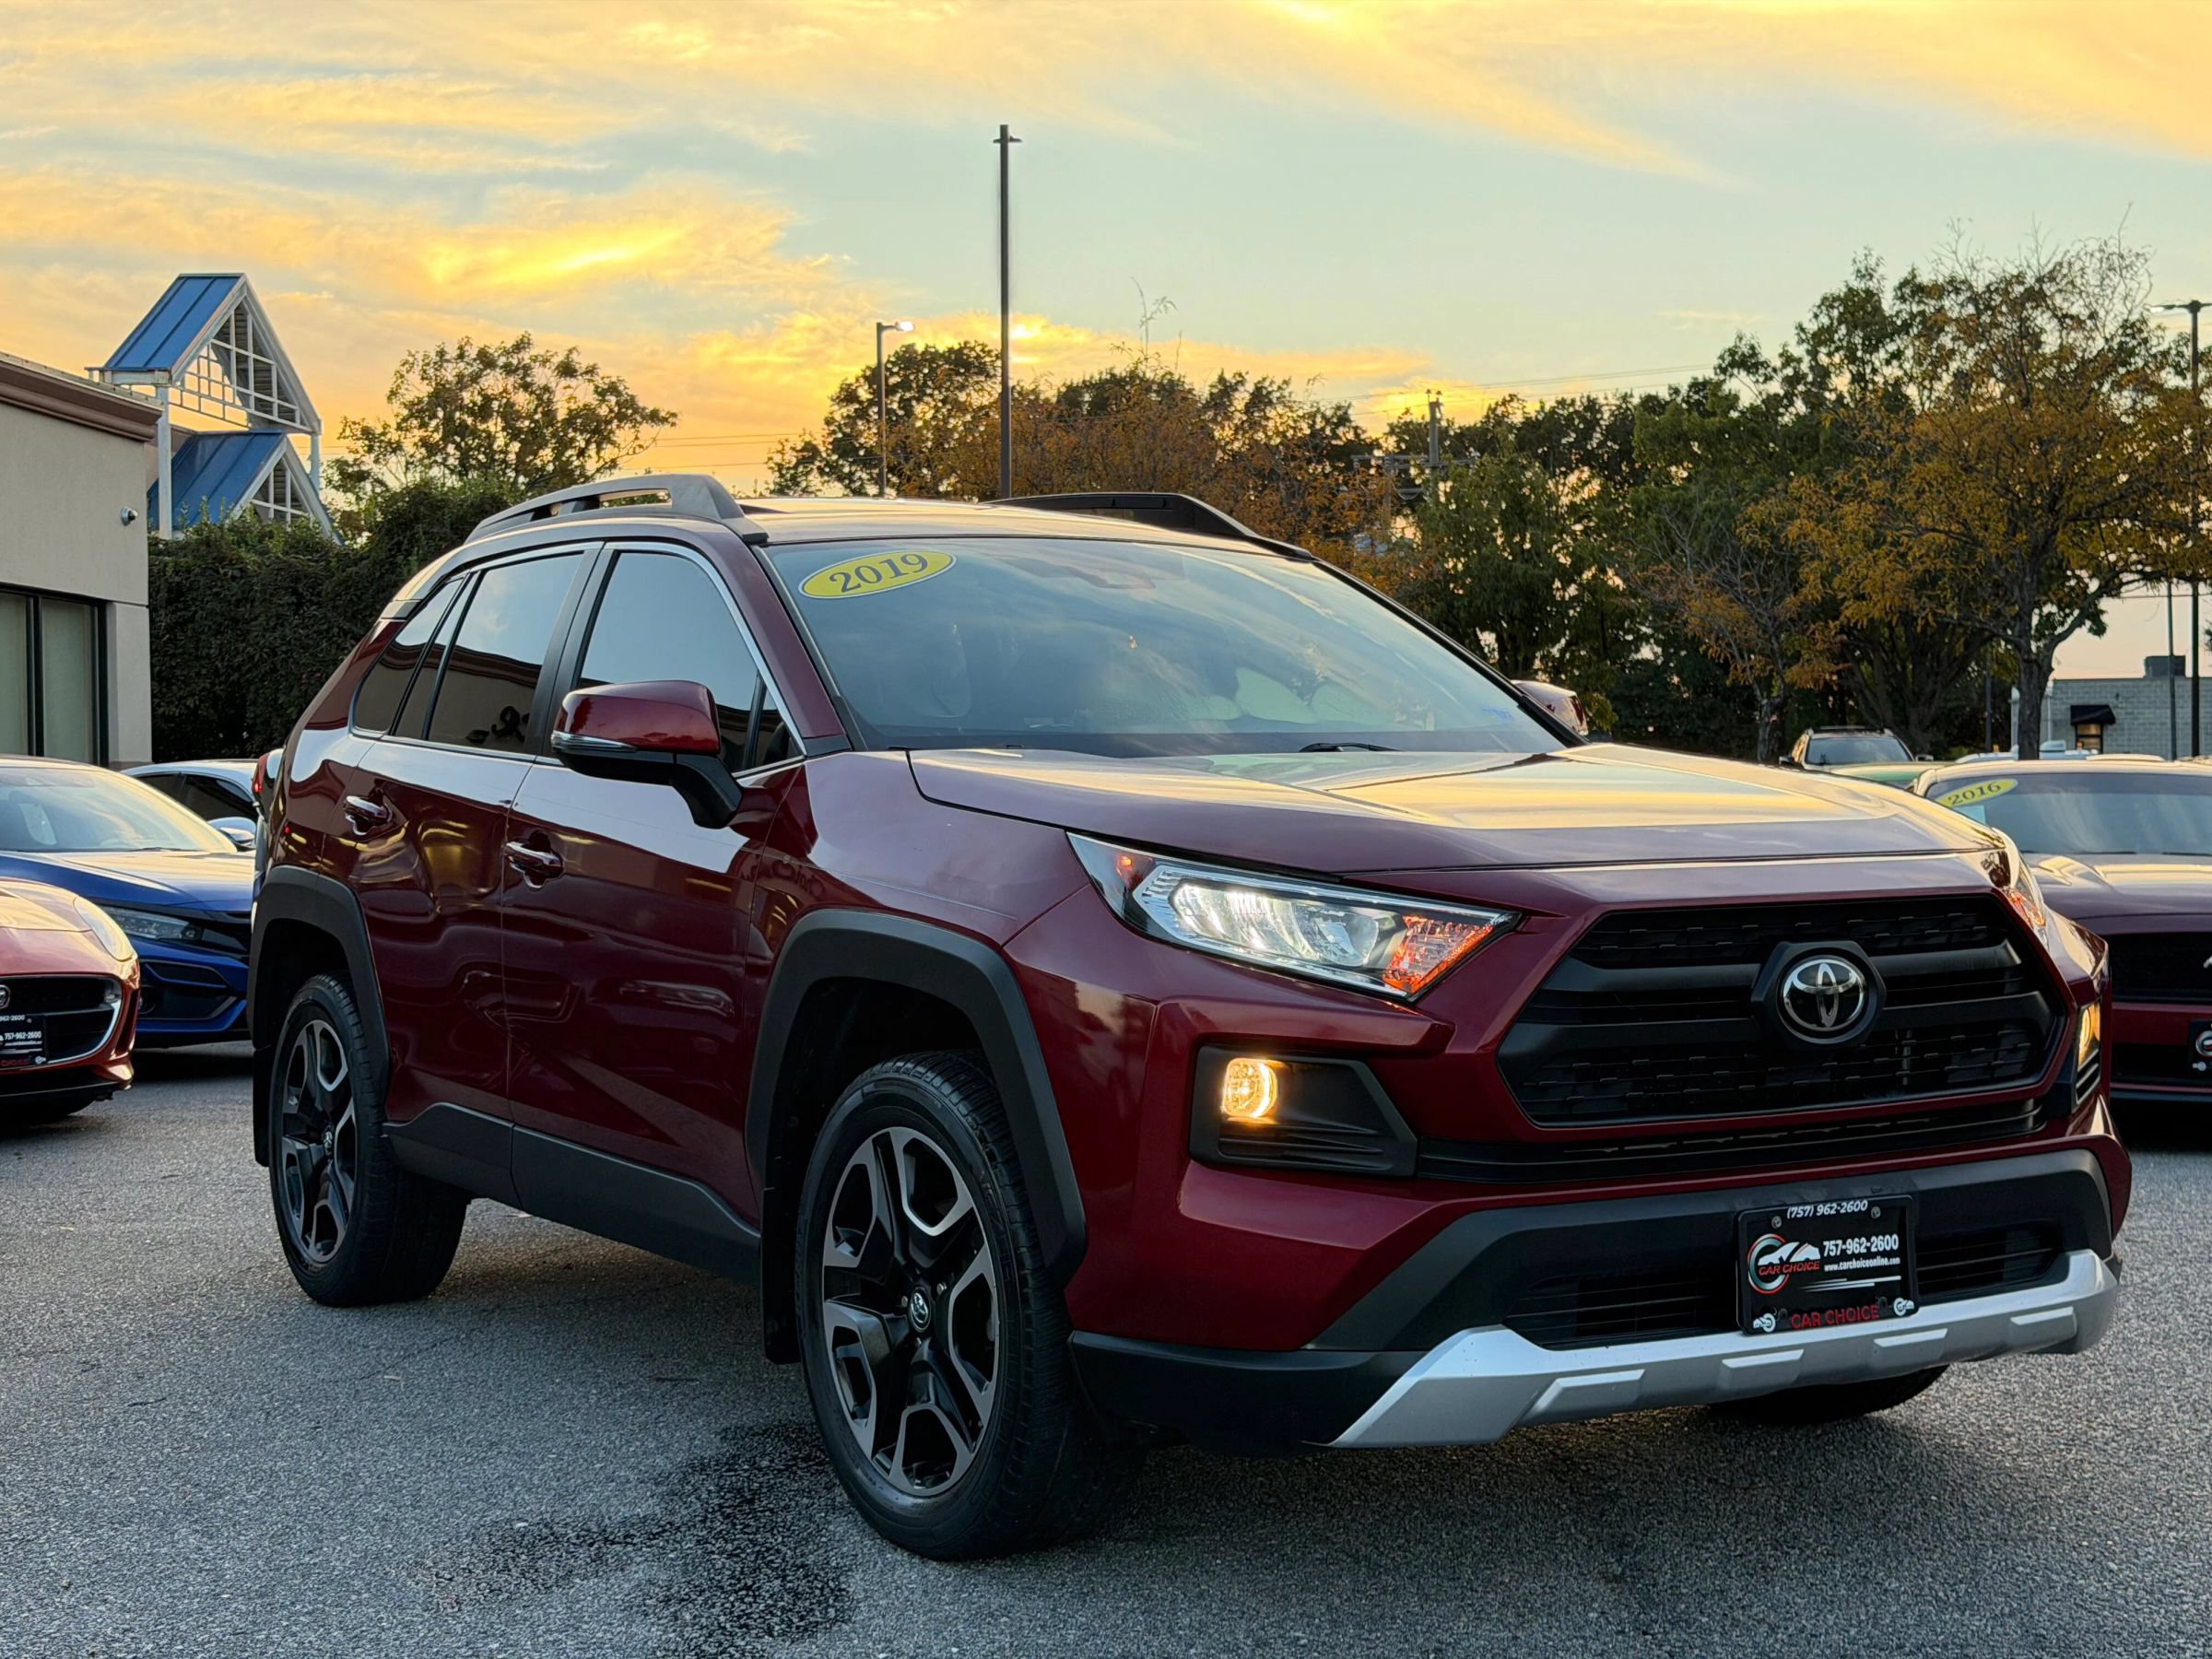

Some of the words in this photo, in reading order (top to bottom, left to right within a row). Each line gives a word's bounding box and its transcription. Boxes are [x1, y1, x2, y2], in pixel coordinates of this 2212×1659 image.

[830, 554, 928, 593] 2019
[1947, 782, 2001, 805] 2016
[1786, 1205, 1814, 1219] (757)
[1816, 1200, 1868, 1216] 962-2600
[1823, 1233, 1899, 1256] 757-962-2600
[1759, 1265, 1780, 1276] CAR
[1783, 1261, 1820, 1273] CHOICE
[1824, 1256, 1900, 1272] www.carchoiceonline.com
[1791, 1313, 1821, 1329] CAR
[1825, 1305, 1879, 1325] CHOICE
